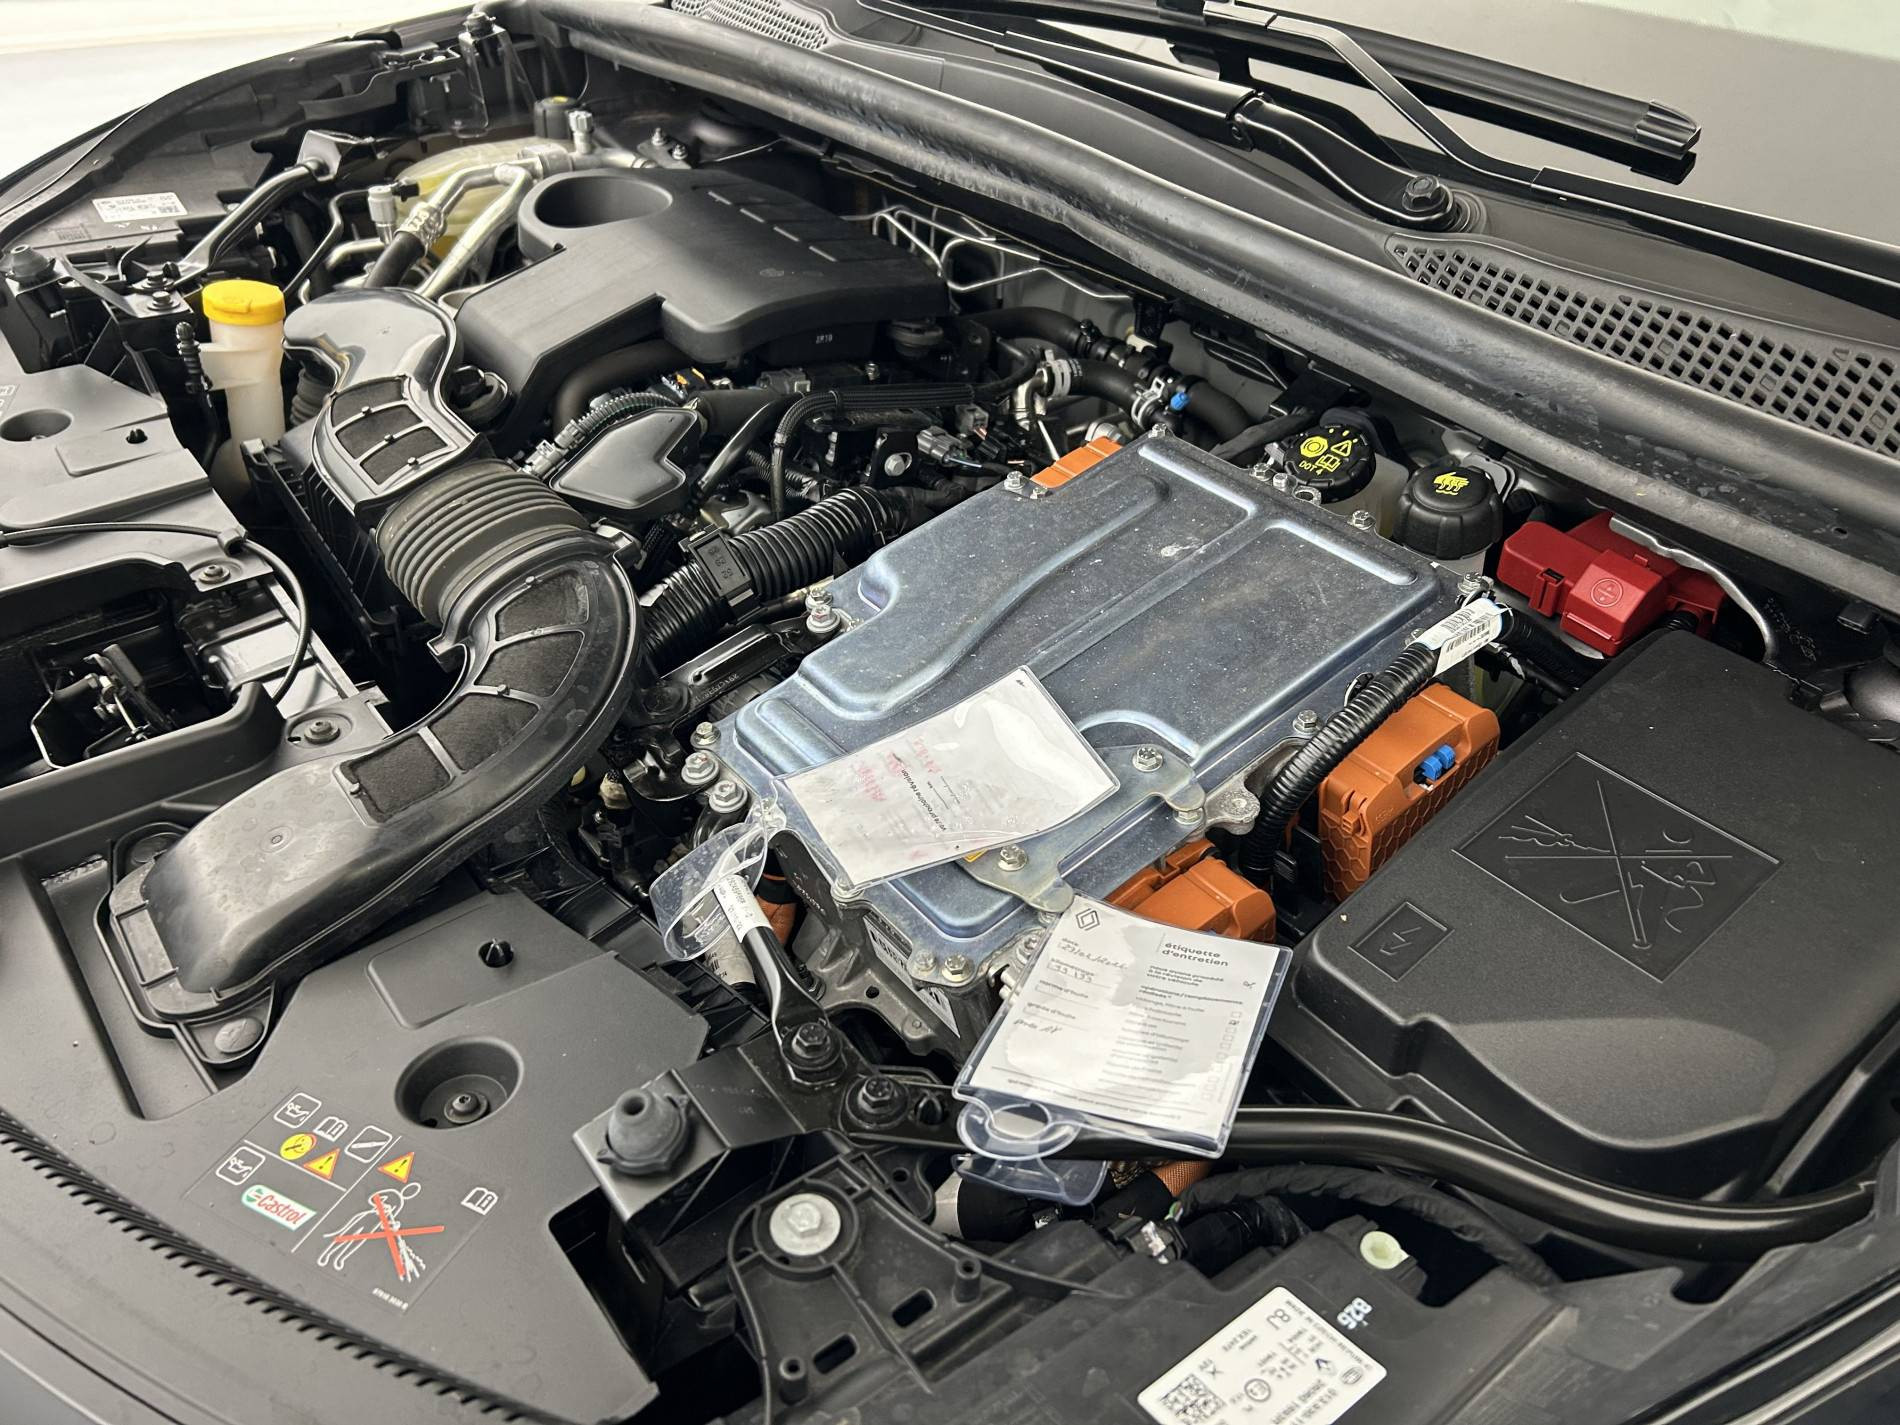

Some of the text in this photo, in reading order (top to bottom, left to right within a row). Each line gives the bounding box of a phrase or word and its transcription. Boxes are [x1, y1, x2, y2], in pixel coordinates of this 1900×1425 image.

[1298, 461, 1323, 476] DOT 4
[900, 768, 918, 791] révision
[1162, 949, 1228, 966] d'entretien
[1165, 942, 1221, 957] étiquette
[257, 1195, 306, 1224] Castrol
